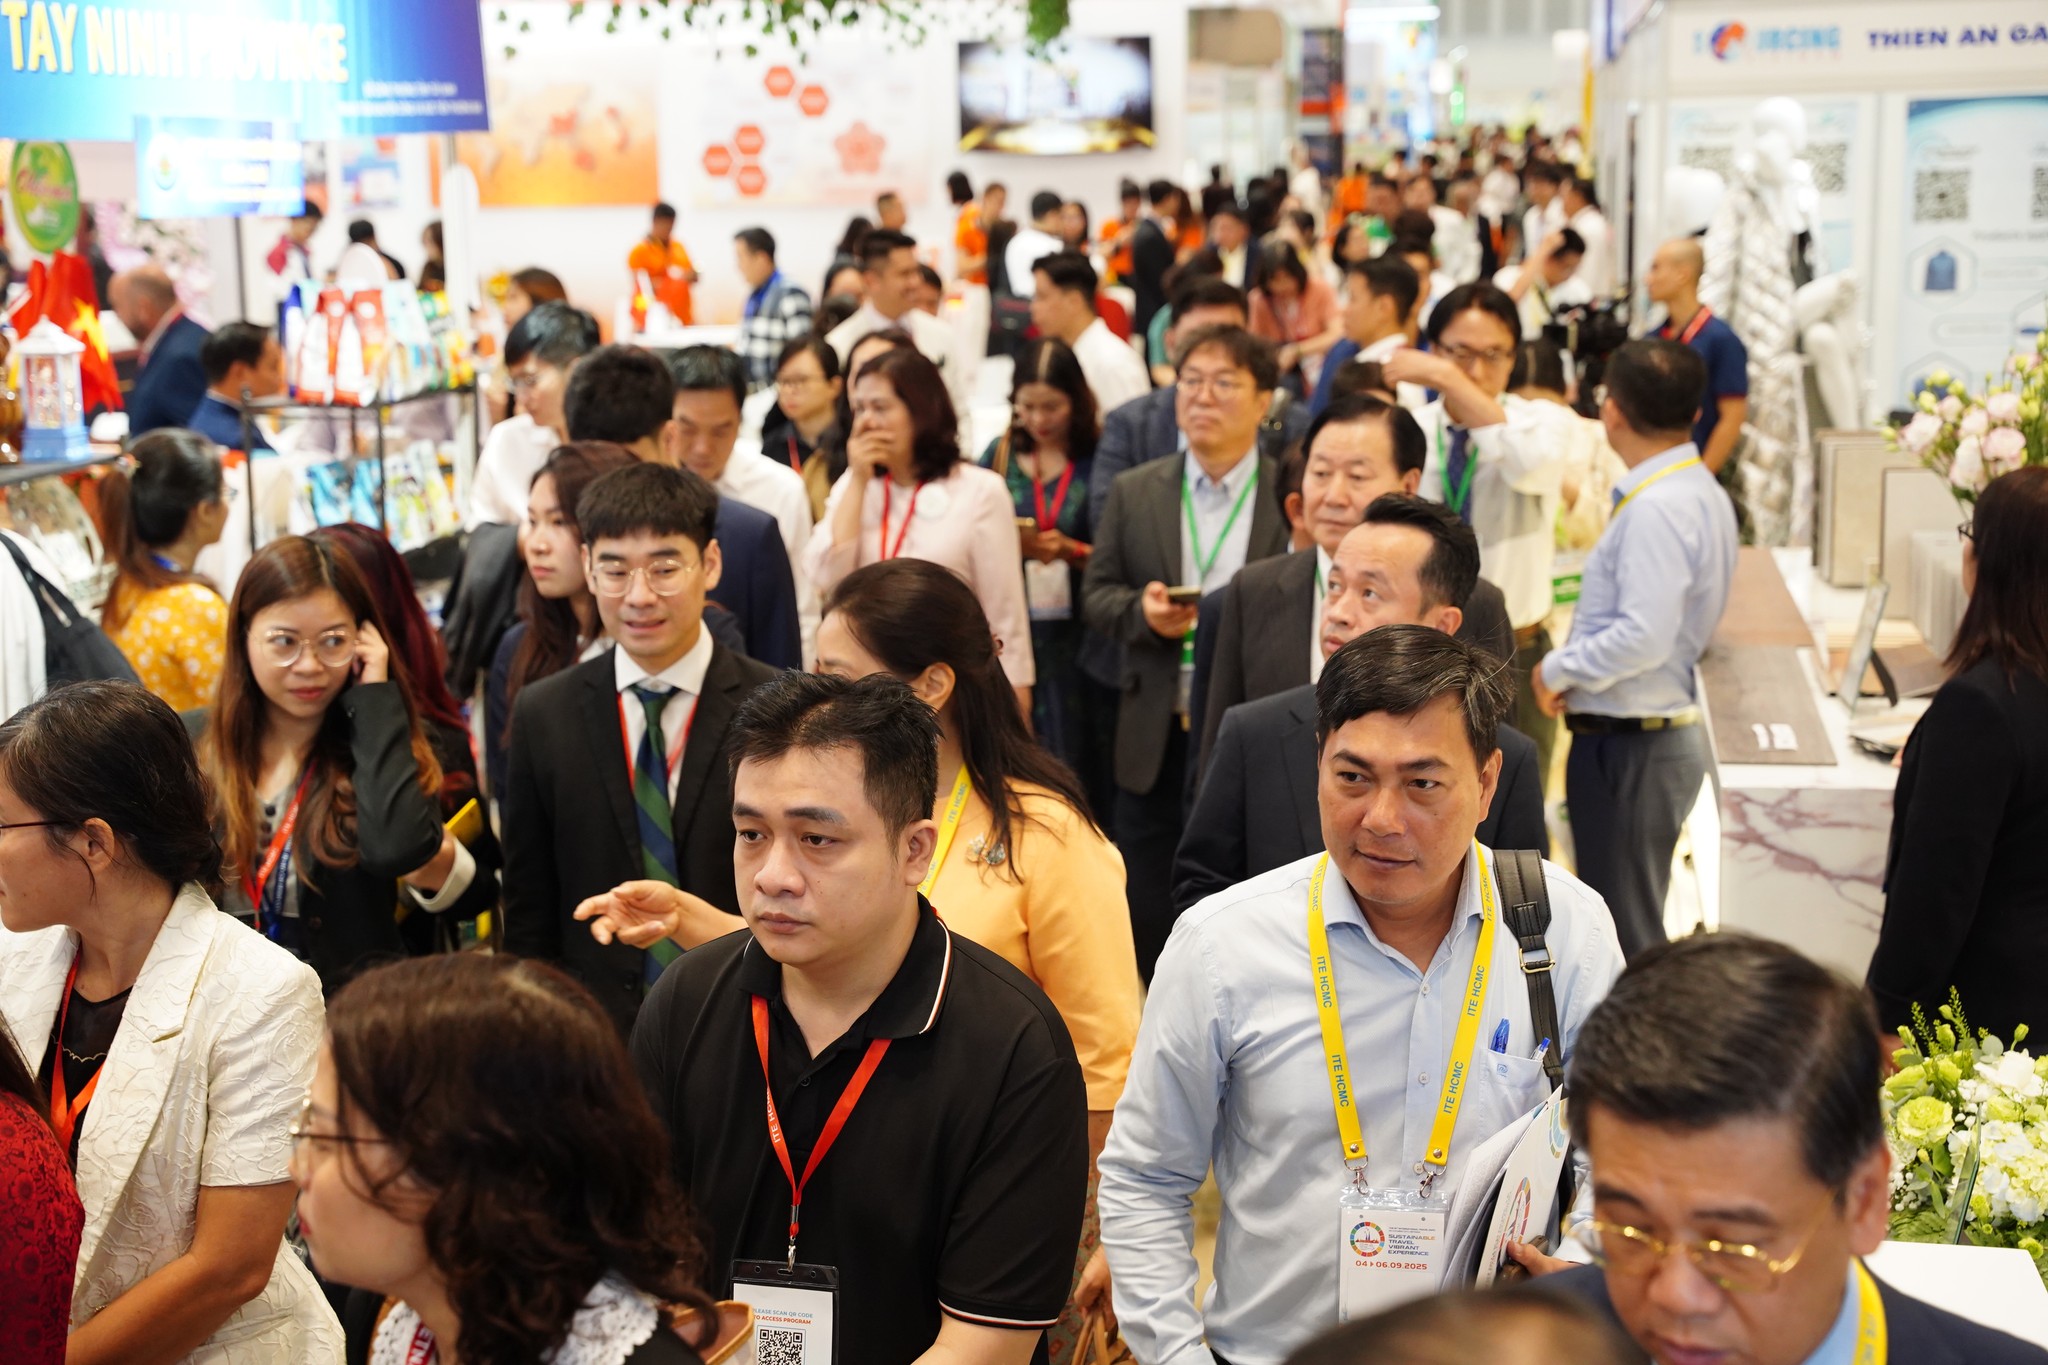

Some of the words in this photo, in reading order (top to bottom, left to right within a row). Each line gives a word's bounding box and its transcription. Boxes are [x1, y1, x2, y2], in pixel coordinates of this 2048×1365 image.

[1, 0, 77, 73] TAY
[84, 4, 182, 78] NINH
[1869, 30, 1948, 47] THIEN
[1959, 27, 1998, 44] AN
[1316, 956, 1327, 973] ITE
[1471, 965, 1485, 998] HCMC
[1320, 975, 1333, 1009] HCMC
[1467, 999, 1479, 1016] ITE
[1331, 1054, 1343, 1072] ITE
[1448, 1061, 1464, 1094] HCMC
[1335, 1074, 1350, 1107] HCMC
[1443, 1096, 1455, 1114] ITE
[770, 1124, 781, 1144] ITE
[1375, 1261, 1428, 1270] 06.09.2025
